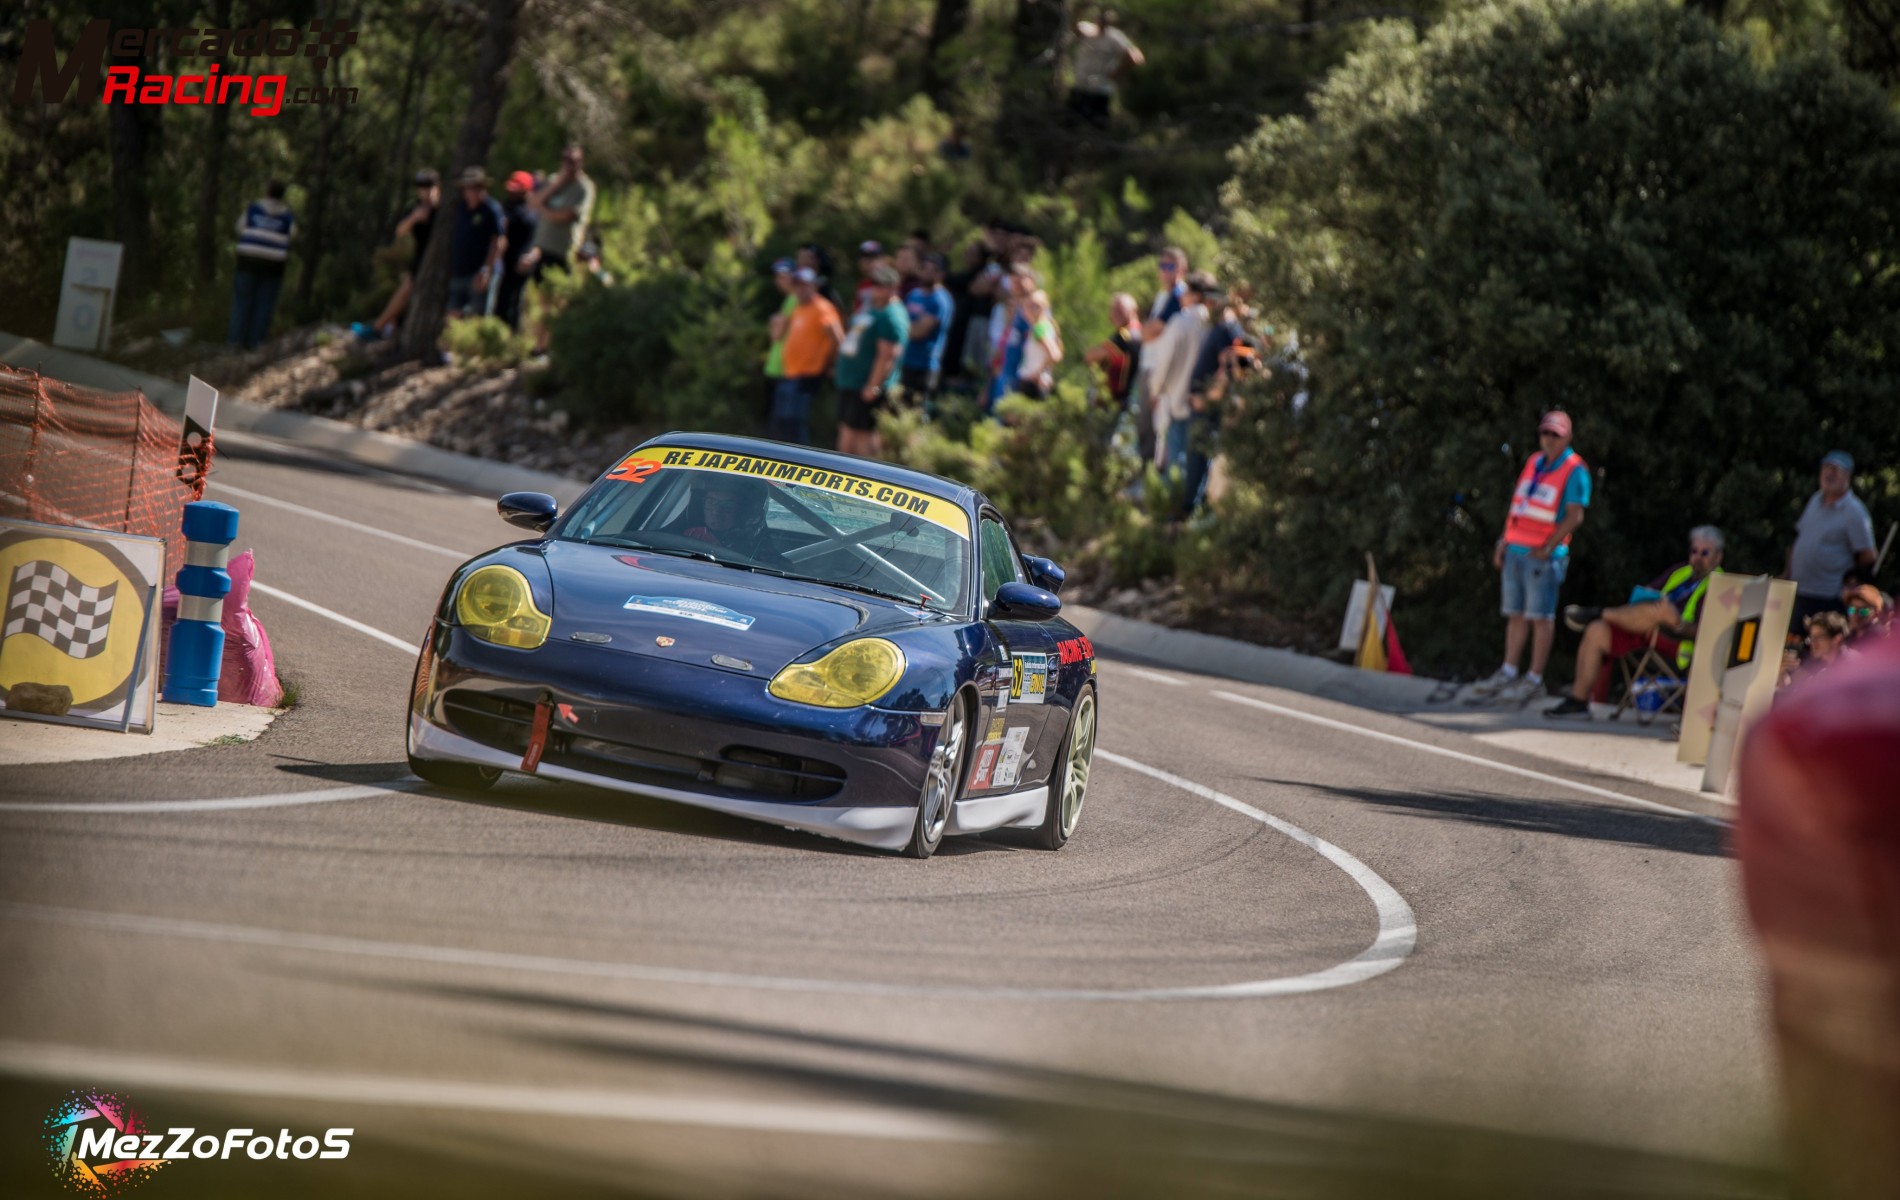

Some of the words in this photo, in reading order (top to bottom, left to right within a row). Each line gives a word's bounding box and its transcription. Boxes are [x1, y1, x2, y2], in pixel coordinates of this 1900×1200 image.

[606, 458, 662, 484] 52
[662, 451, 694, 465] RE
[695, 452, 931, 515] JAPANIMPORTS.COM
[1012, 659, 1023, 697] 52
